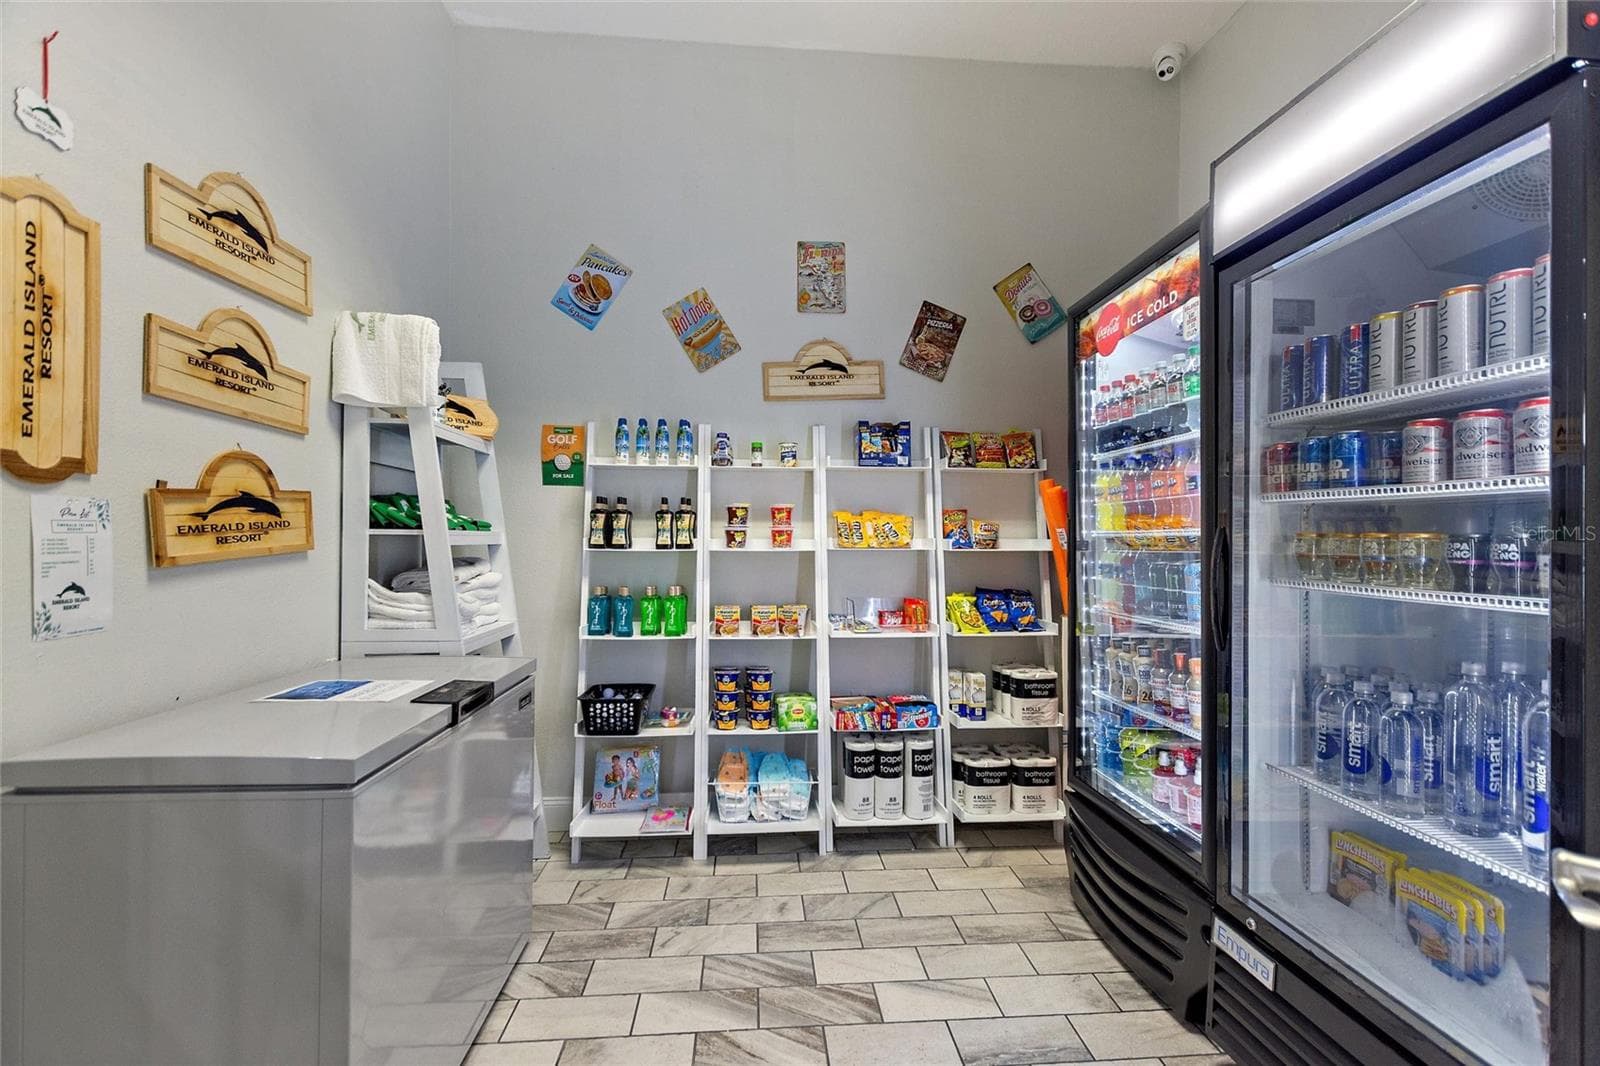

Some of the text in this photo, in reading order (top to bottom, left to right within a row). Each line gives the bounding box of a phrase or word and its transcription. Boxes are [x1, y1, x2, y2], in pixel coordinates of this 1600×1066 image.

[188, 213, 276, 265] EMERALD ISLAND
[581, 256, 628, 277] Pancakes
[21, 220, 37, 438] EMERALD ISLAND
[671, 296, 713, 337] Hot Dogs
[1127, 290, 1178, 329] ICE COLD
[187, 356, 275, 391] EMERALD ISLAND
[1349, 343, 1364, 391] ULTRA
[455, 417, 483, 427] ISLAND
[547, 434, 578, 445] GOLF
[176, 520, 291, 535] EMERALD ISLAND
[1318, 713, 1327, 753] smart
[1348, 721, 1362, 768] smart
[1424, 734, 1434, 782] smart
[1487, 736, 1501, 793] smart
[1536, 762, 1547, 793] water
[594, 801, 617, 809] Float
[1523, 760, 1536, 824] smart
[1400, 879, 1457, 920] LUNCHABLES
[1218, 925, 1270, 981] Empura
